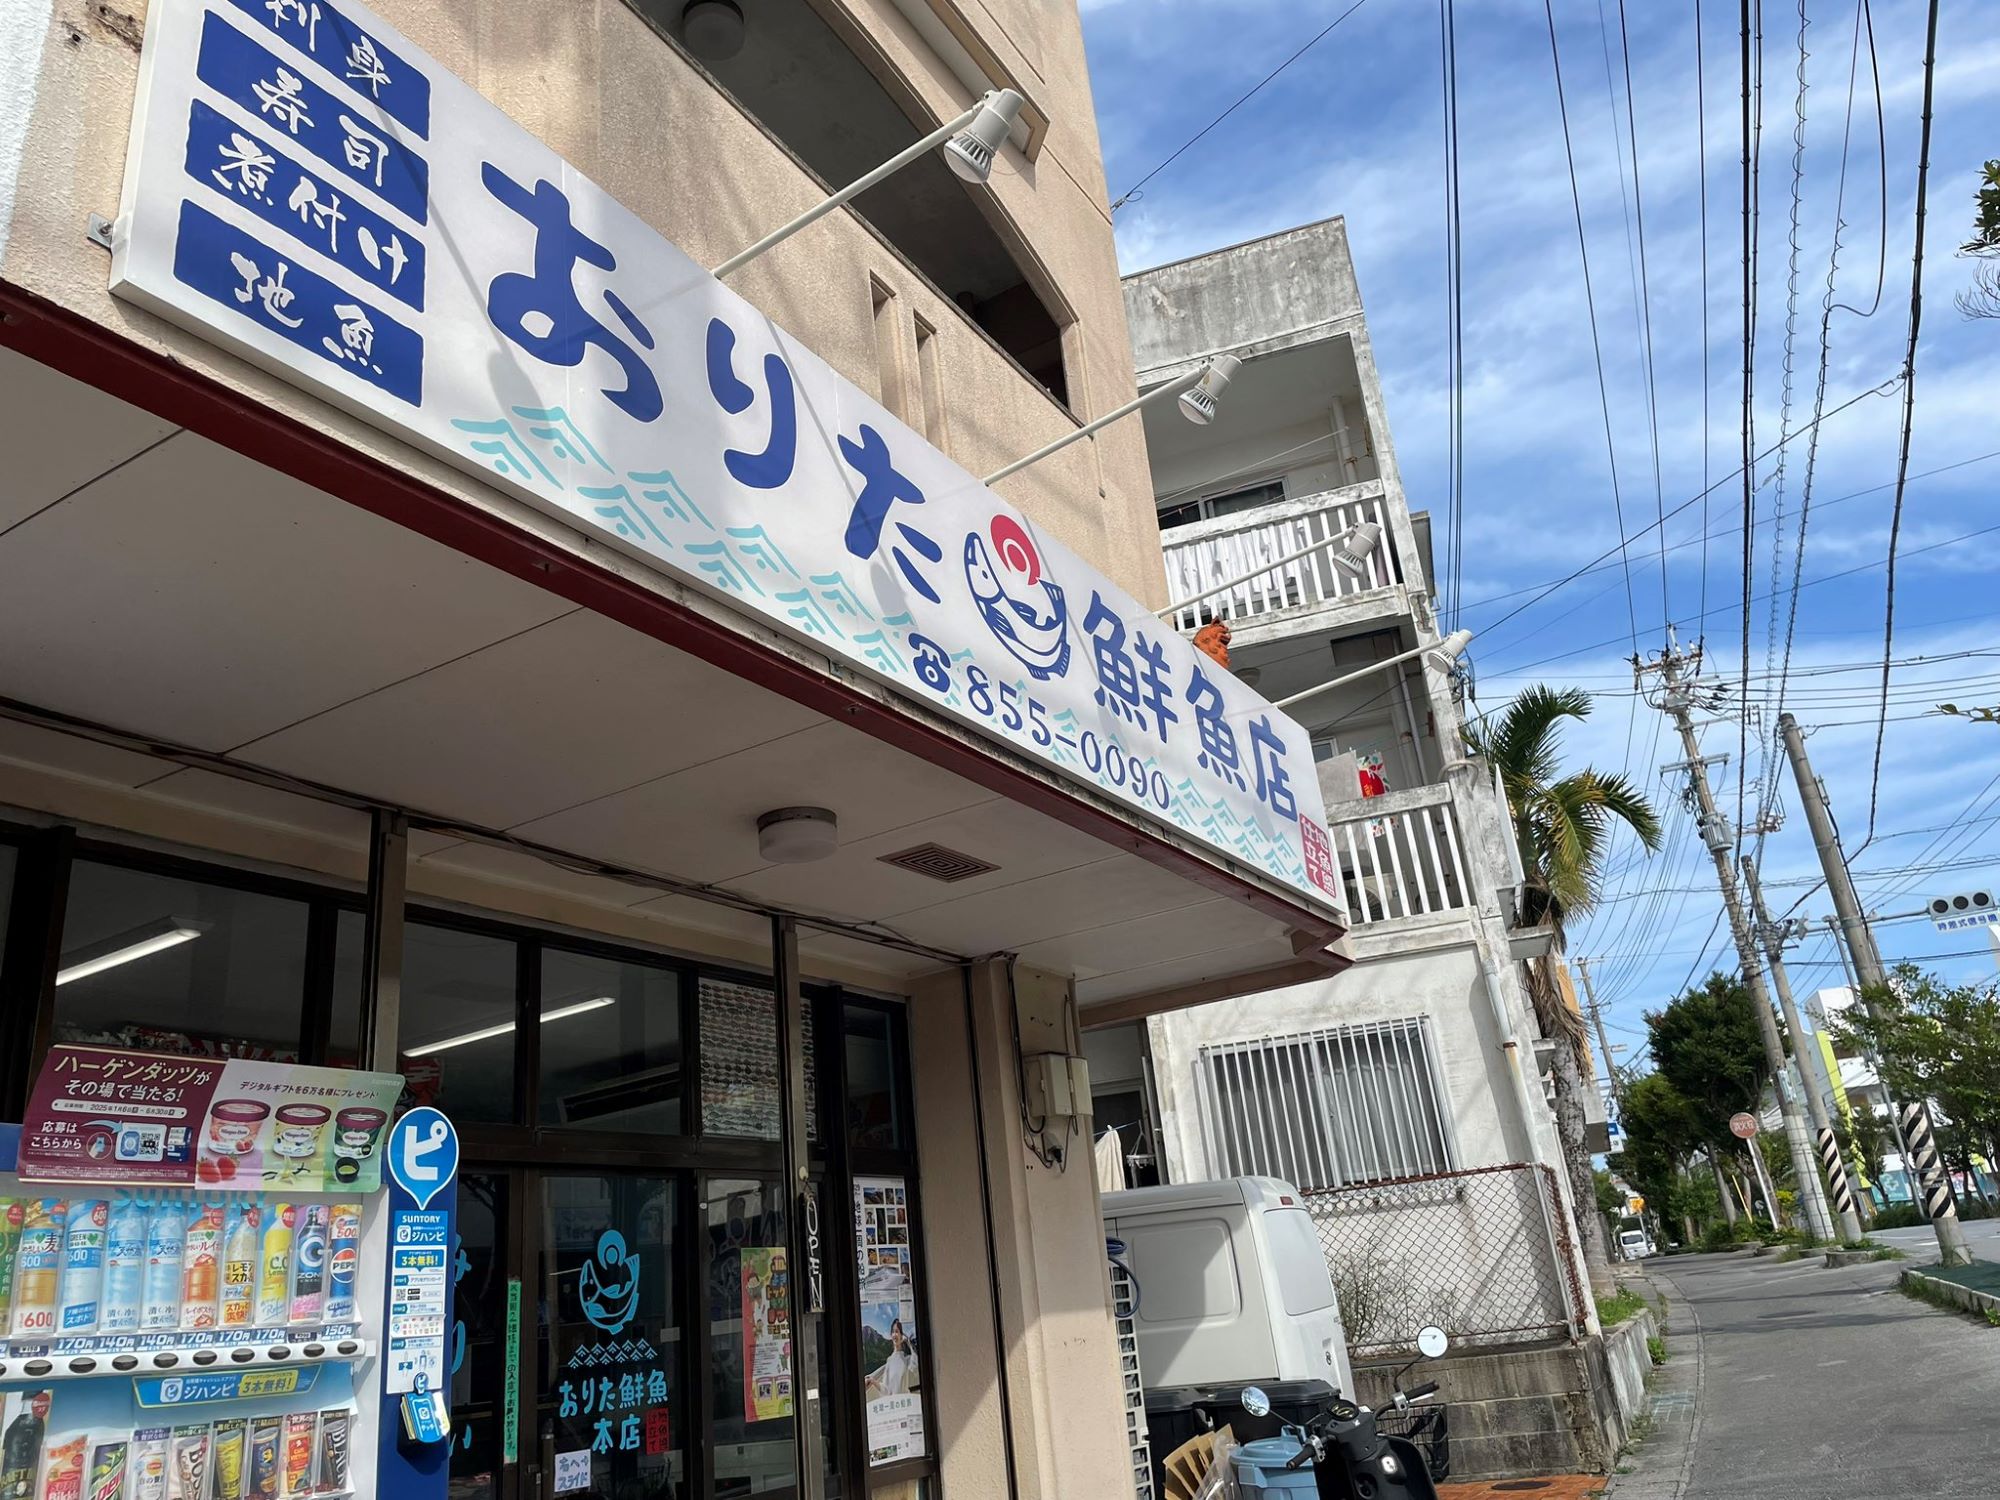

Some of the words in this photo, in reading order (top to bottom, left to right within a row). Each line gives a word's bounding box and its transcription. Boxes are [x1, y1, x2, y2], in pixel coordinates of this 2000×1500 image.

[251, 67, 390, 187] 寿司
[211, 132, 410, 285] 煮付け
[230, 251, 383, 375] 地魚
[481, 161, 943, 604] おりた
[1082, 590, 1298, 823] 鮮魚店
[968, 664, 1170, 811] 855-0090
[54, 1055, 213, 1086] ハーゲンダッツが
[40, 1120, 77, 1135] 応募は
[30, 1135, 83, 1150] こちらから
[403, 1119, 449, 1181] ピ
[402, 1215, 441, 1223] SUNTORY
[412, 1231, 445, 1242] ジハンピ
[401, 1256, 439, 1266] 3本無料!
[806, 1200, 823, 1309] OPEN
[180, 1332, 214, 1344] 170円
[218, 1330, 251, 1342] 170円
[256, 1329, 285, 1340] 170円
[324, 1324, 352, 1336] 150円
[58, 1338, 95, 1349] 170円
[99, 1336, 135, 1347] 140円
[140, 1334, 175, 1346] 140円
[184, 1383, 235, 1400] ジハンピ
[242, 1377, 292, 1393] 3本無料!
[558, 1368, 669, 1418] おりた鮮魚
[592, 1413, 641, 1455] 本店
[558, 1472, 589, 1490] スライド
